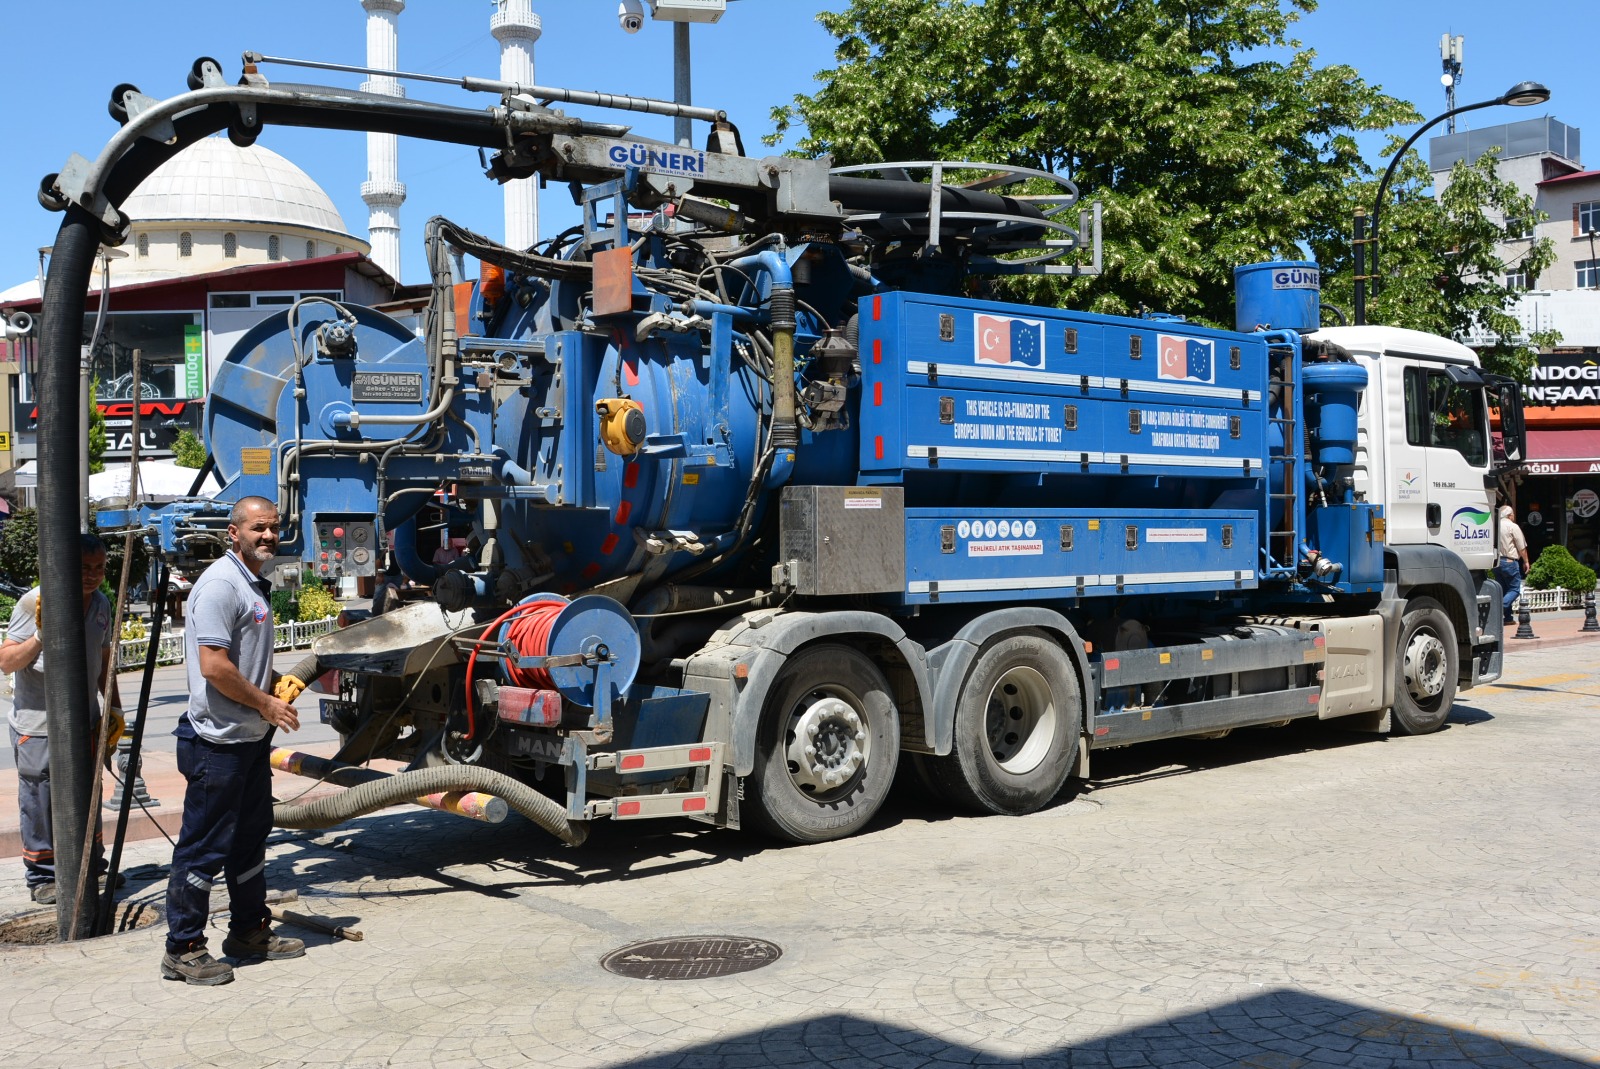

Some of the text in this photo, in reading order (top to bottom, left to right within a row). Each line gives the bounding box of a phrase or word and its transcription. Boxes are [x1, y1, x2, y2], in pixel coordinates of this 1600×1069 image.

[609, 143, 704, 173] GÜNERİ
[1275, 269, 1318, 285] GÜNE
[187, 353, 201, 397] bonus
[1530, 360, 1600, 381] NDOĞ
[966, 400, 977, 416] THIS
[978, 401, 997, 417] VEHICLE
[998, 402, 1004, 418] IS
[1004, 402, 1034, 419] CO-FINANCED
[1041, 404, 1050, 420] THE
[954, 423, 1062, 443] EUROPEAN UNION AND THE REPUBLIC OF TURKEY
[1331, 663, 1365, 680] MAN
[519, 736, 562, 758] MAN
